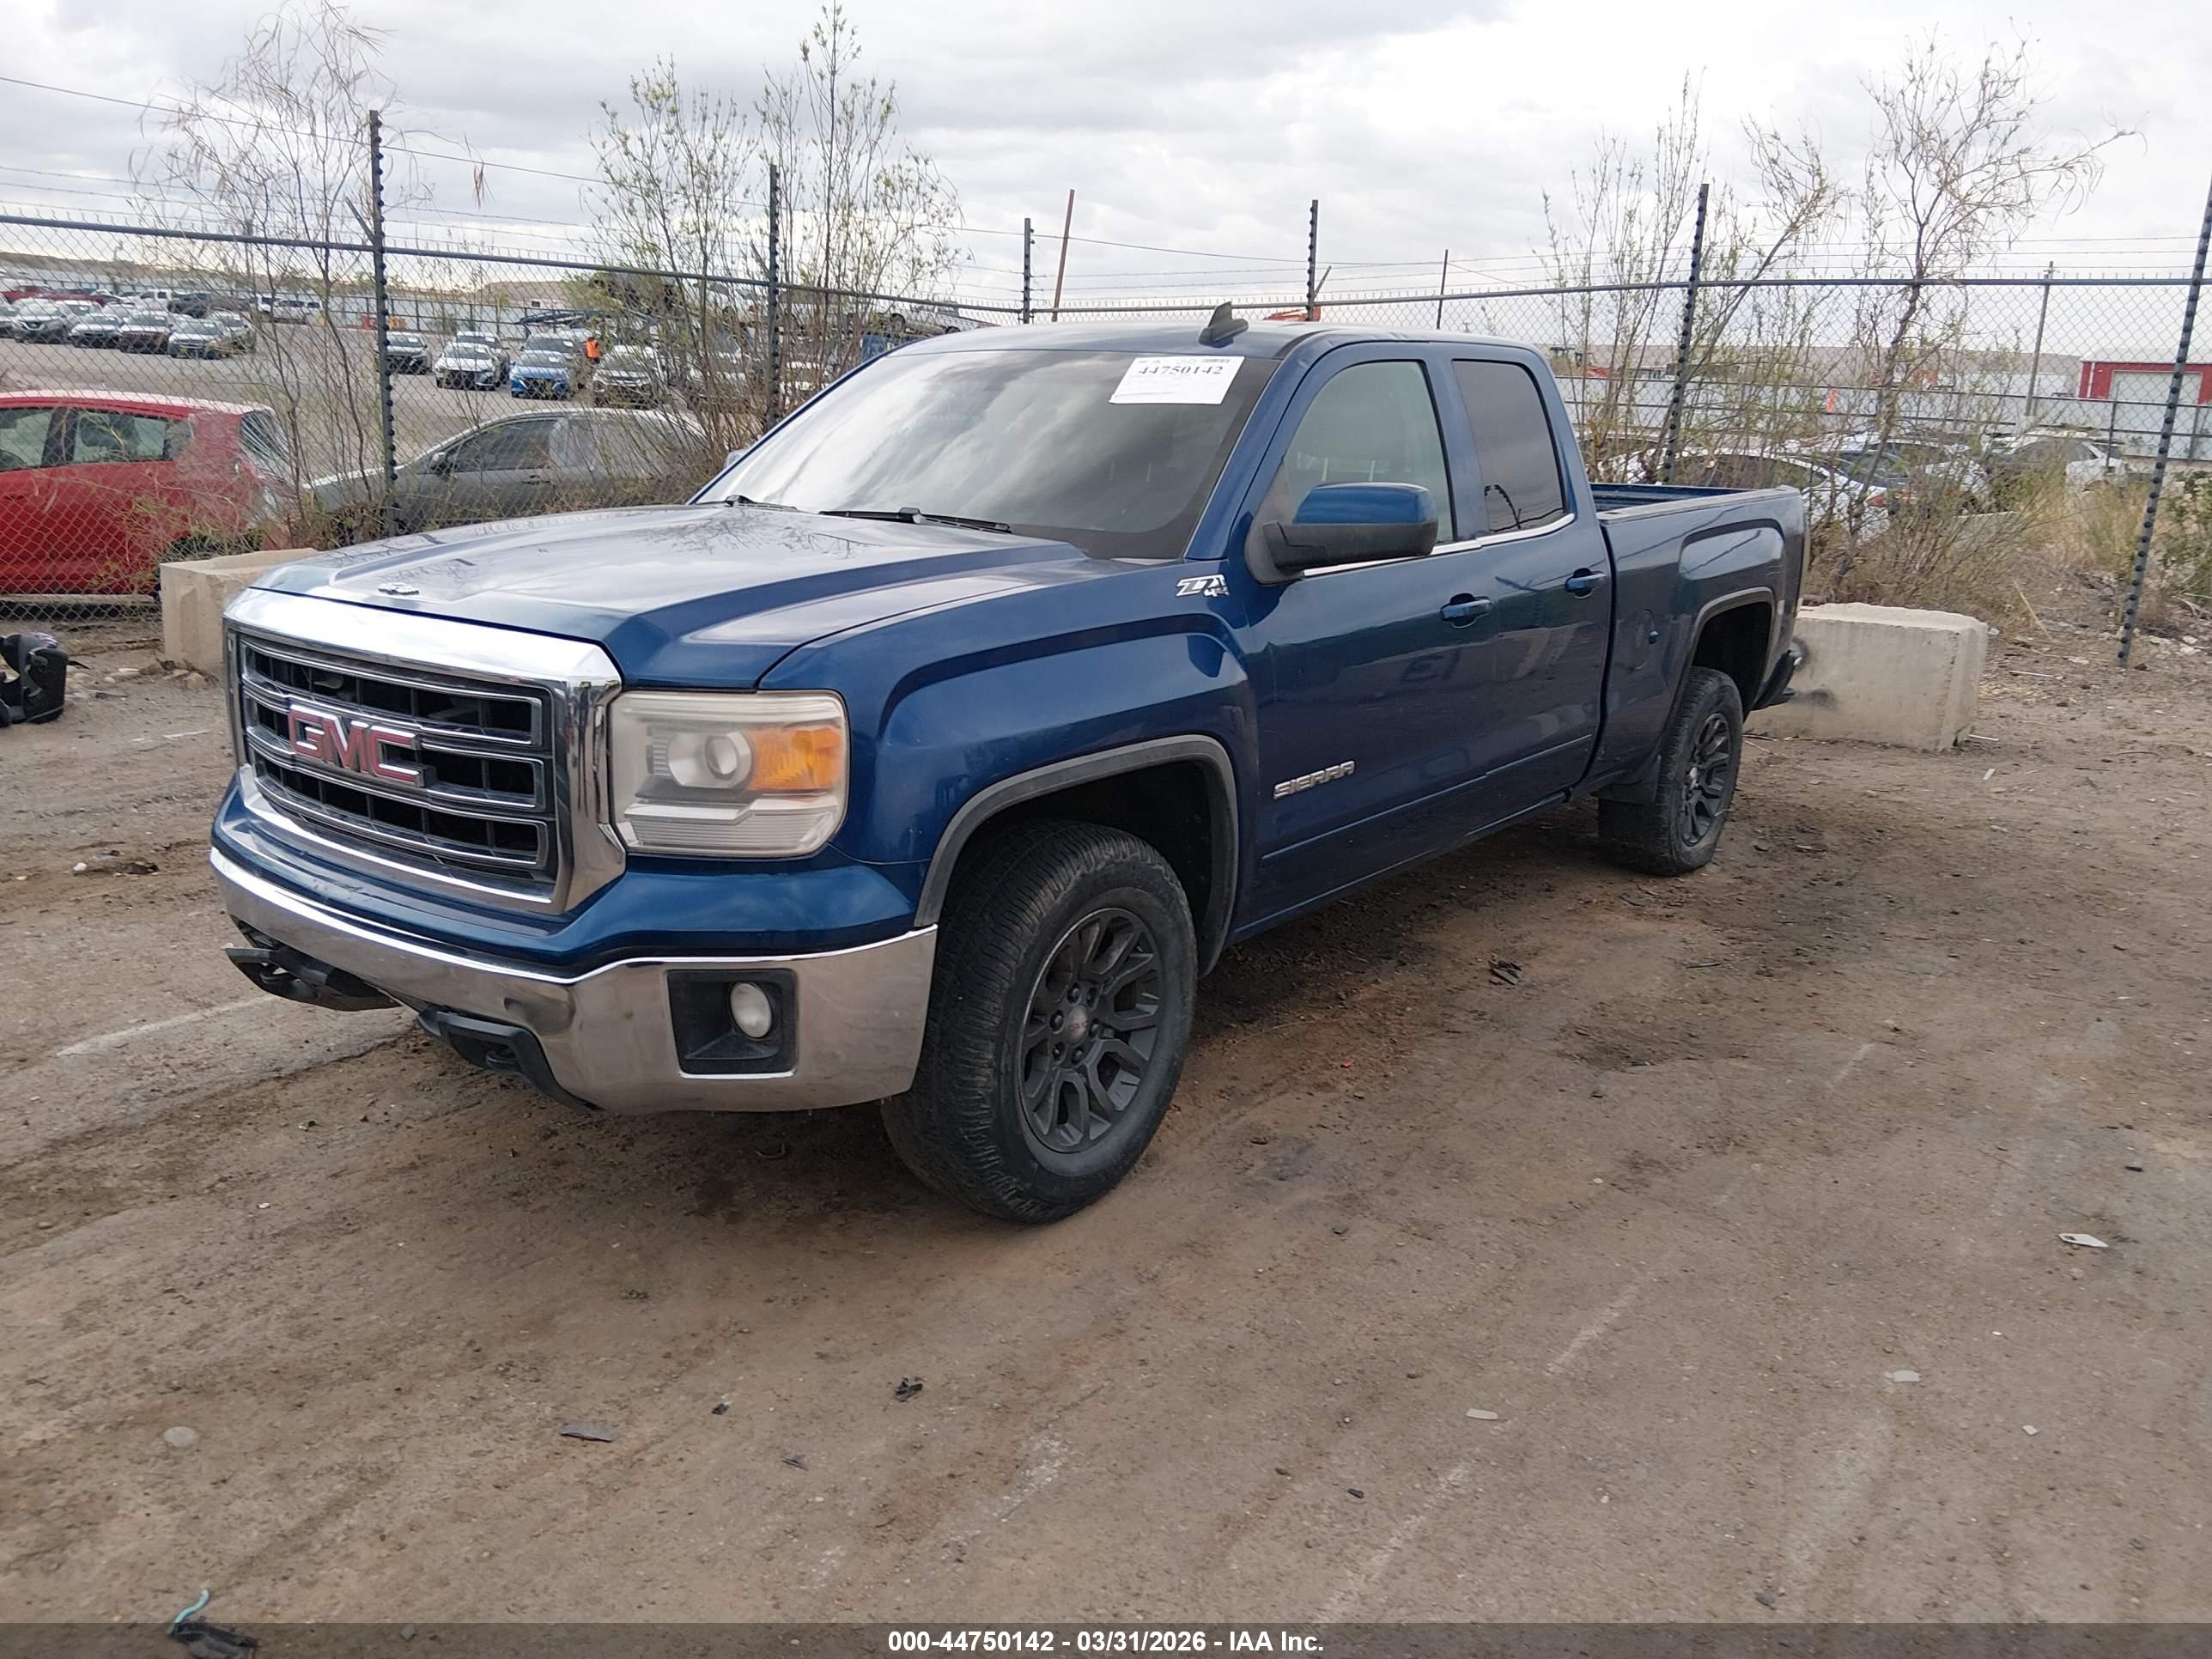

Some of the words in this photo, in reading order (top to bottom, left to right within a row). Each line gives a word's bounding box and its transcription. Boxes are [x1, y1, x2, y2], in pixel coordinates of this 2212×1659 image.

[1138, 365, 1224, 375] 44750142
[287, 704, 424, 788] GMC
[1273, 760, 1355, 799] SIERRA
